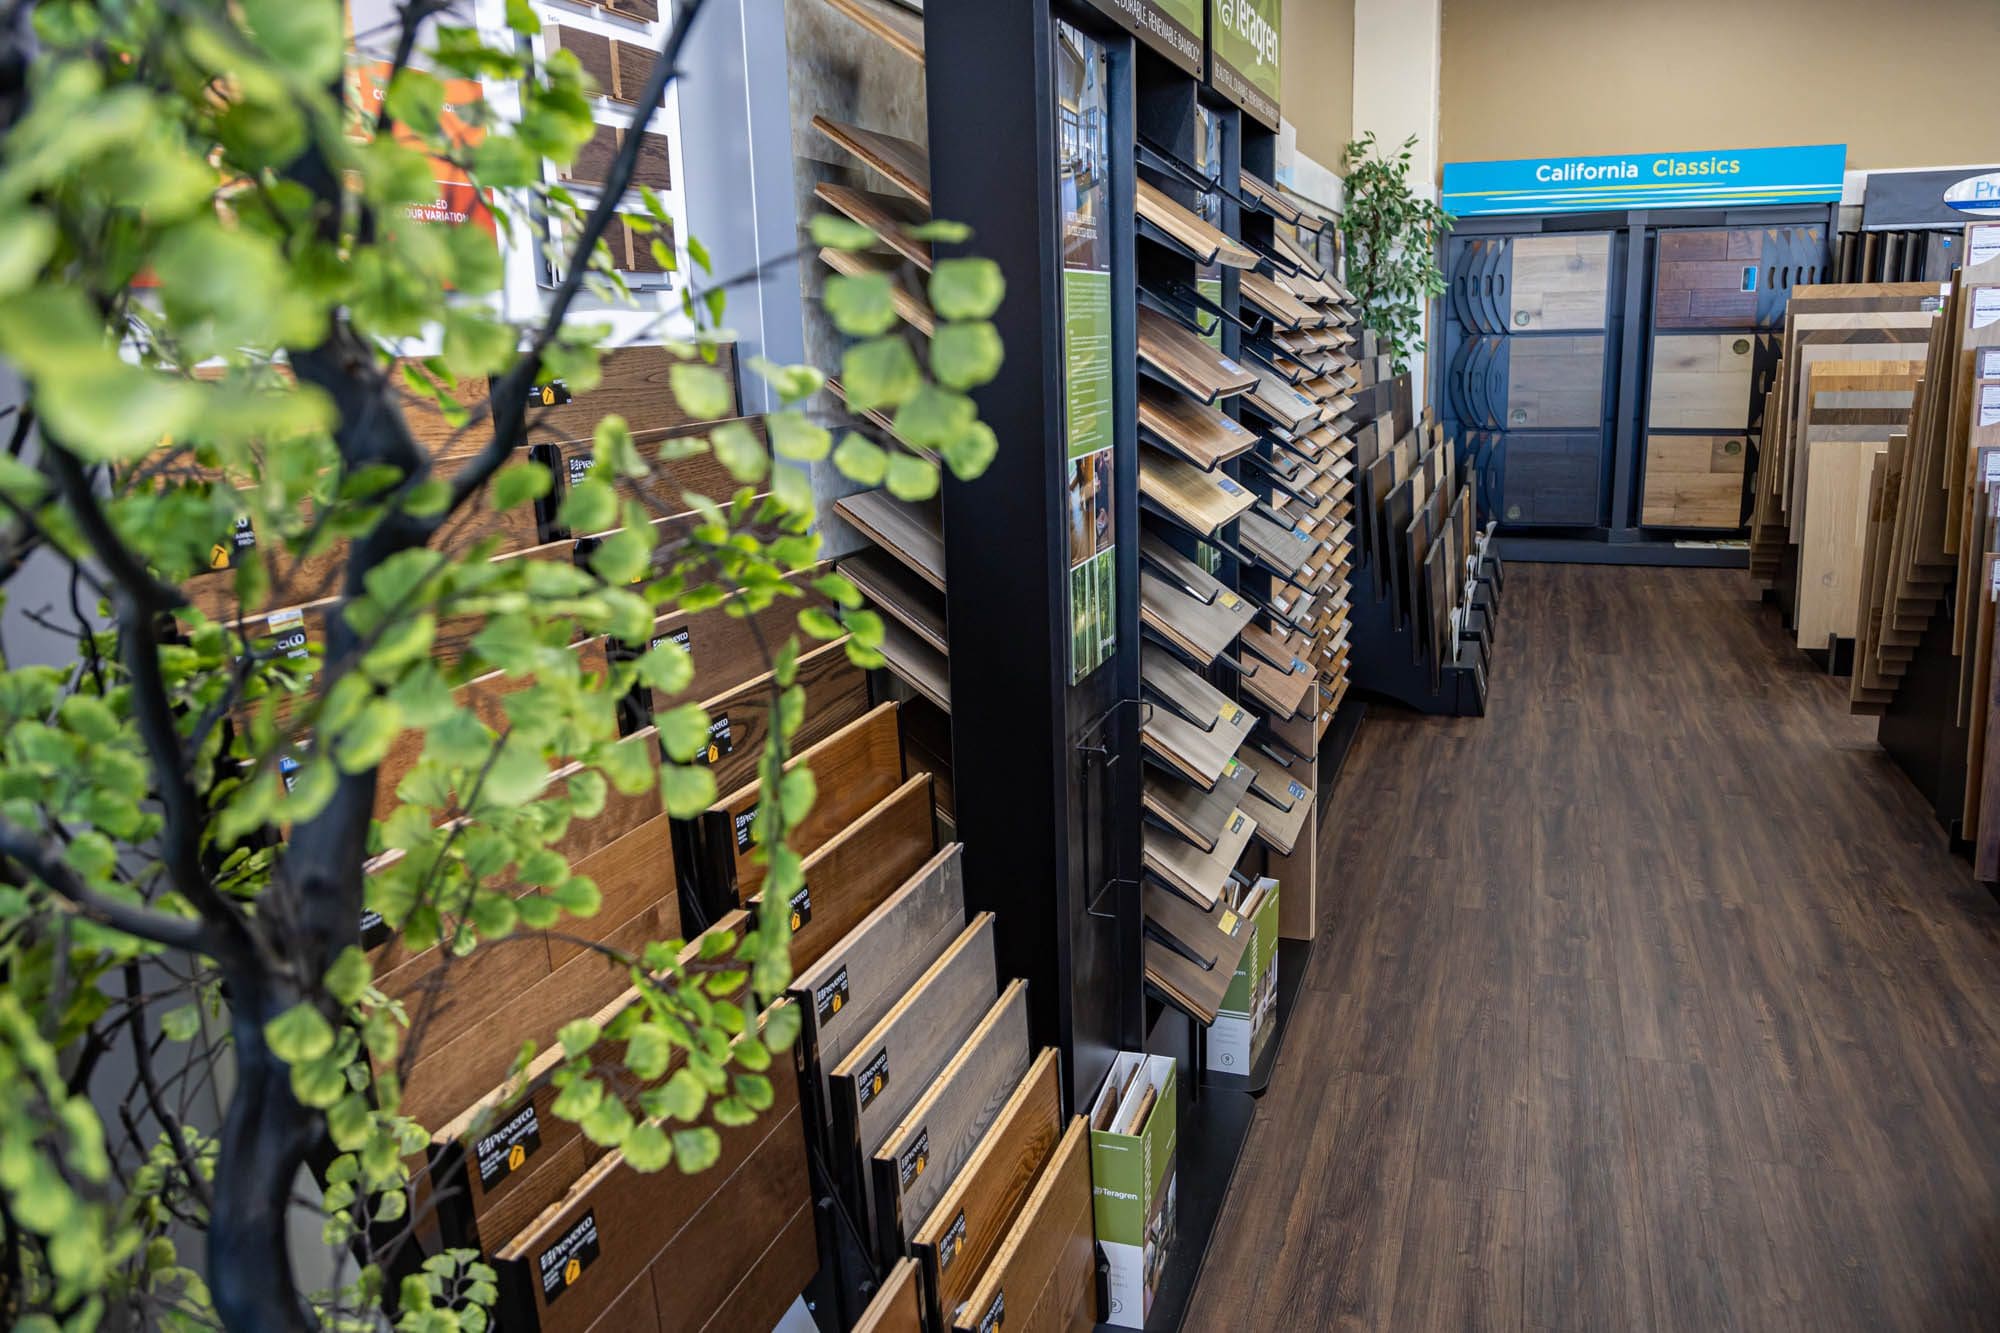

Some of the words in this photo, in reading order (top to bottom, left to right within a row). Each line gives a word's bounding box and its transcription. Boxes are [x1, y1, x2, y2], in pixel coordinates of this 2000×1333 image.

[1535, 160, 1639, 182] California
[1652, 157, 1741, 177] Classics
[489, 1106, 534, 1149] Preverco
[1103, 1187, 1139, 1201] Teragren
[550, 1216, 593, 1260] Preverco
